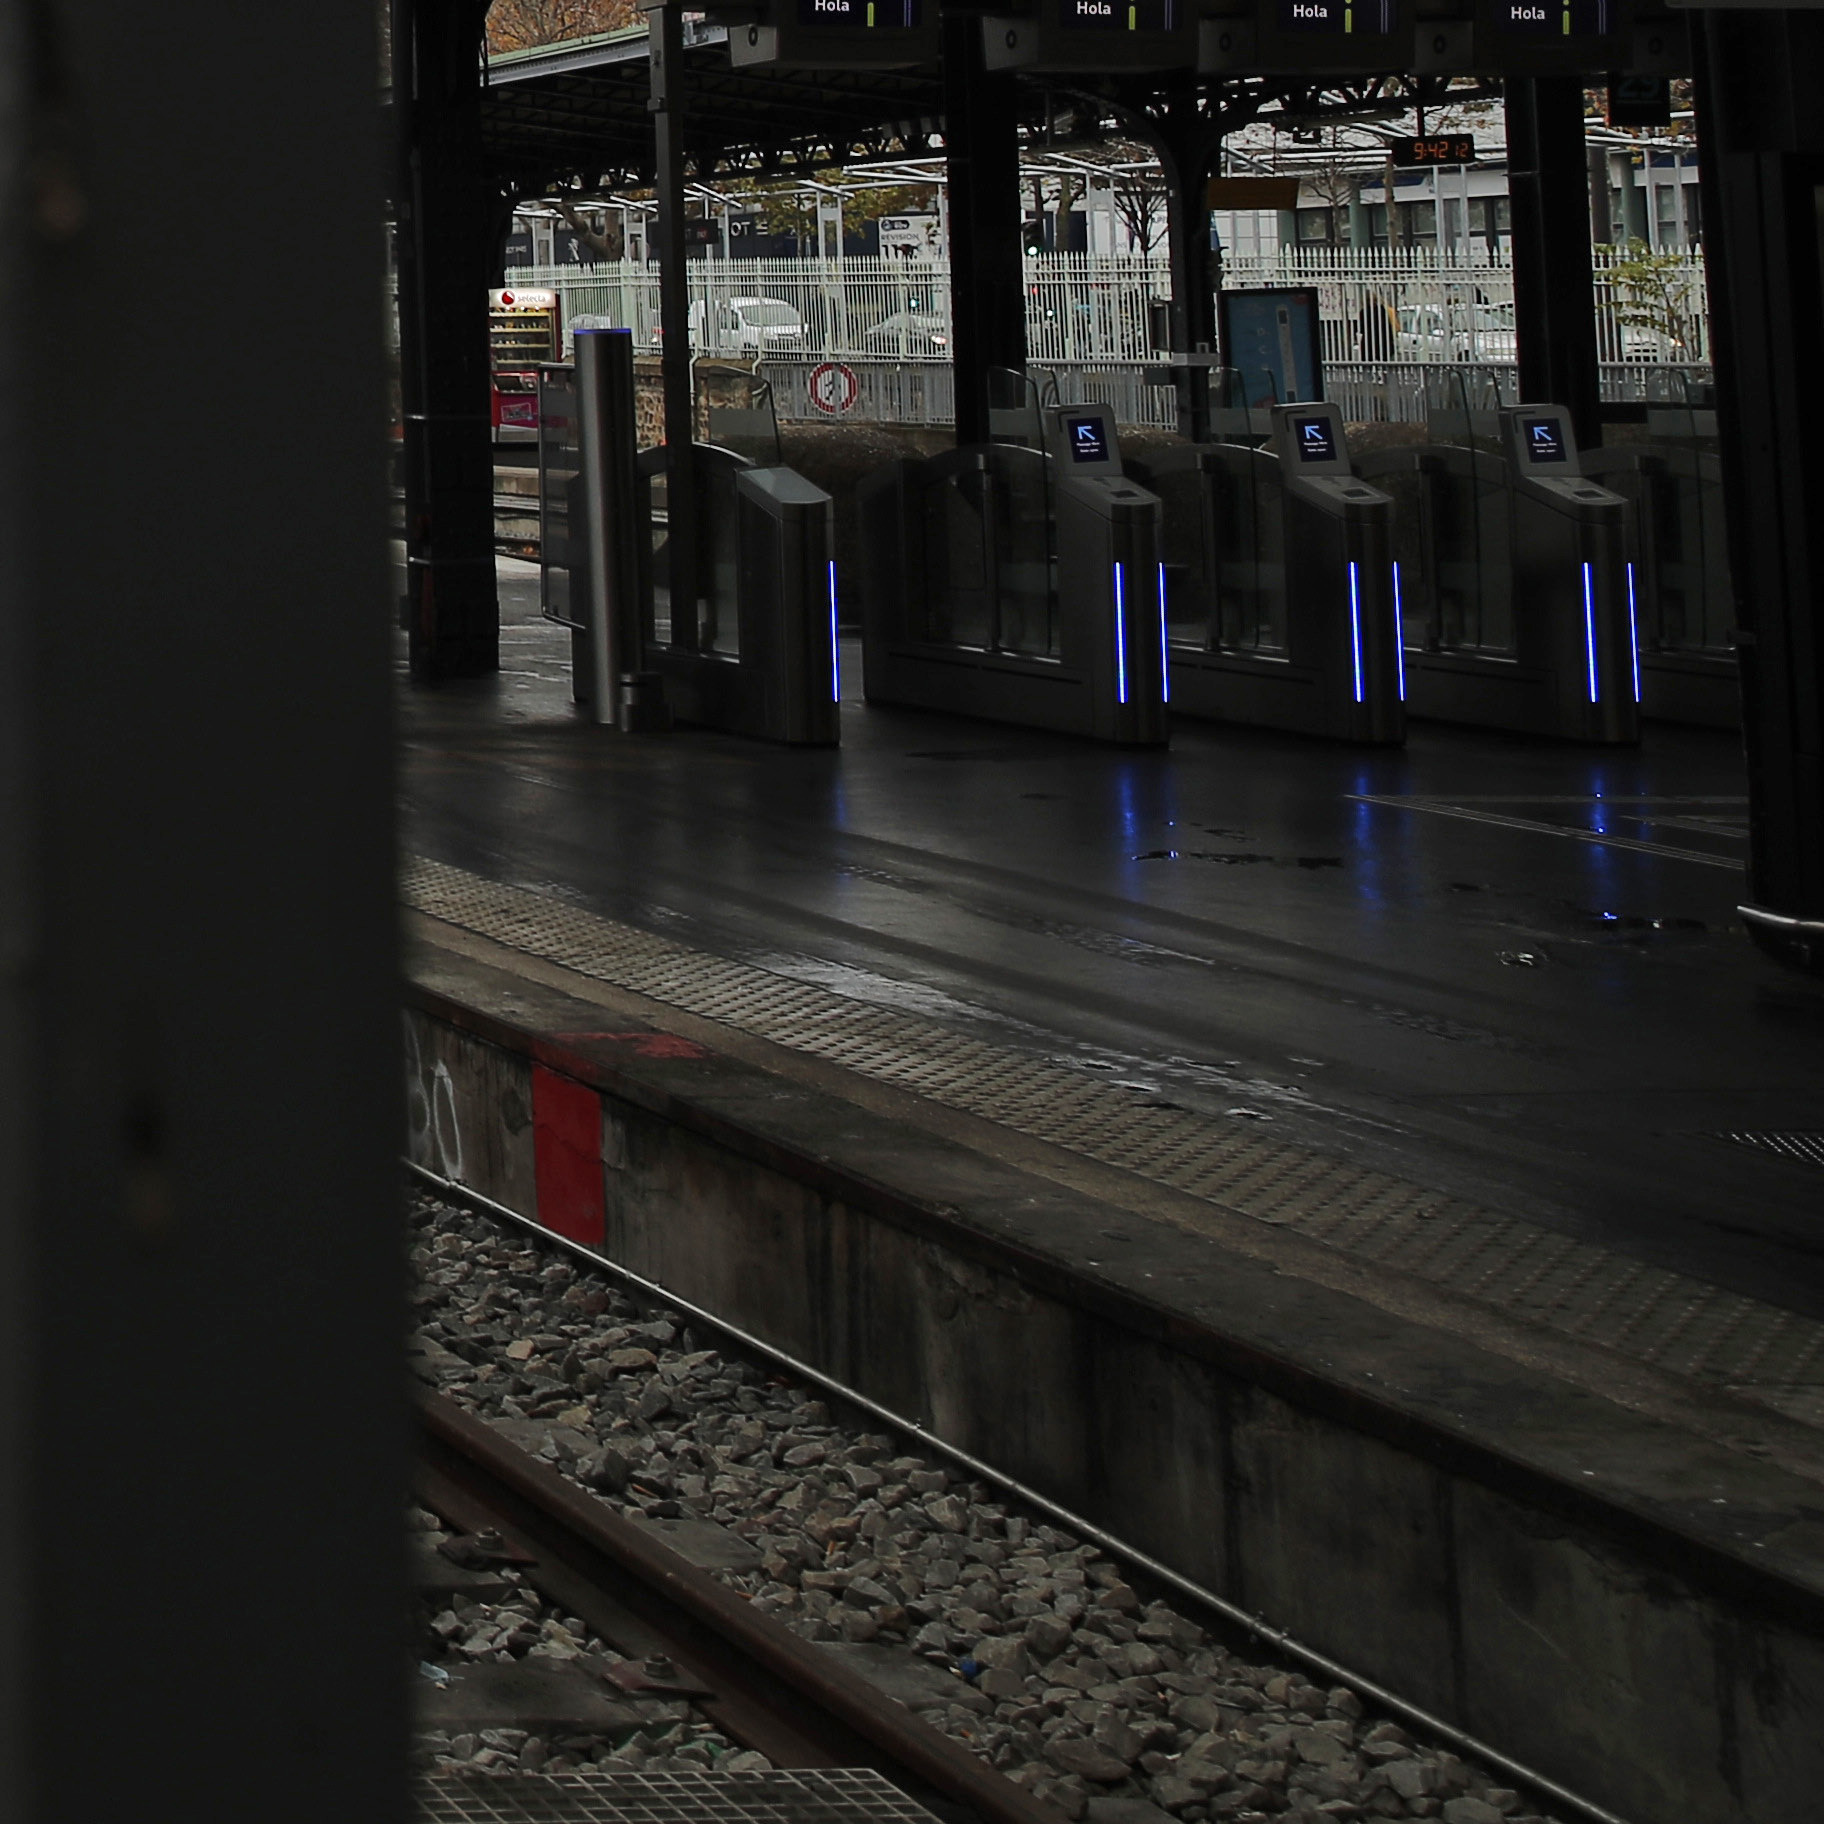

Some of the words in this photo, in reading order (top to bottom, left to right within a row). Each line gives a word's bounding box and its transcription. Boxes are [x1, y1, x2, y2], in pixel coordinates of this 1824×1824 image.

[1076, 1, 1111, 15] Hola
[1293, 4, 1328, 18] Hola
[1511, 6, 1546, 20] Hola
[1414, 140, 1449, 160] 9:42
